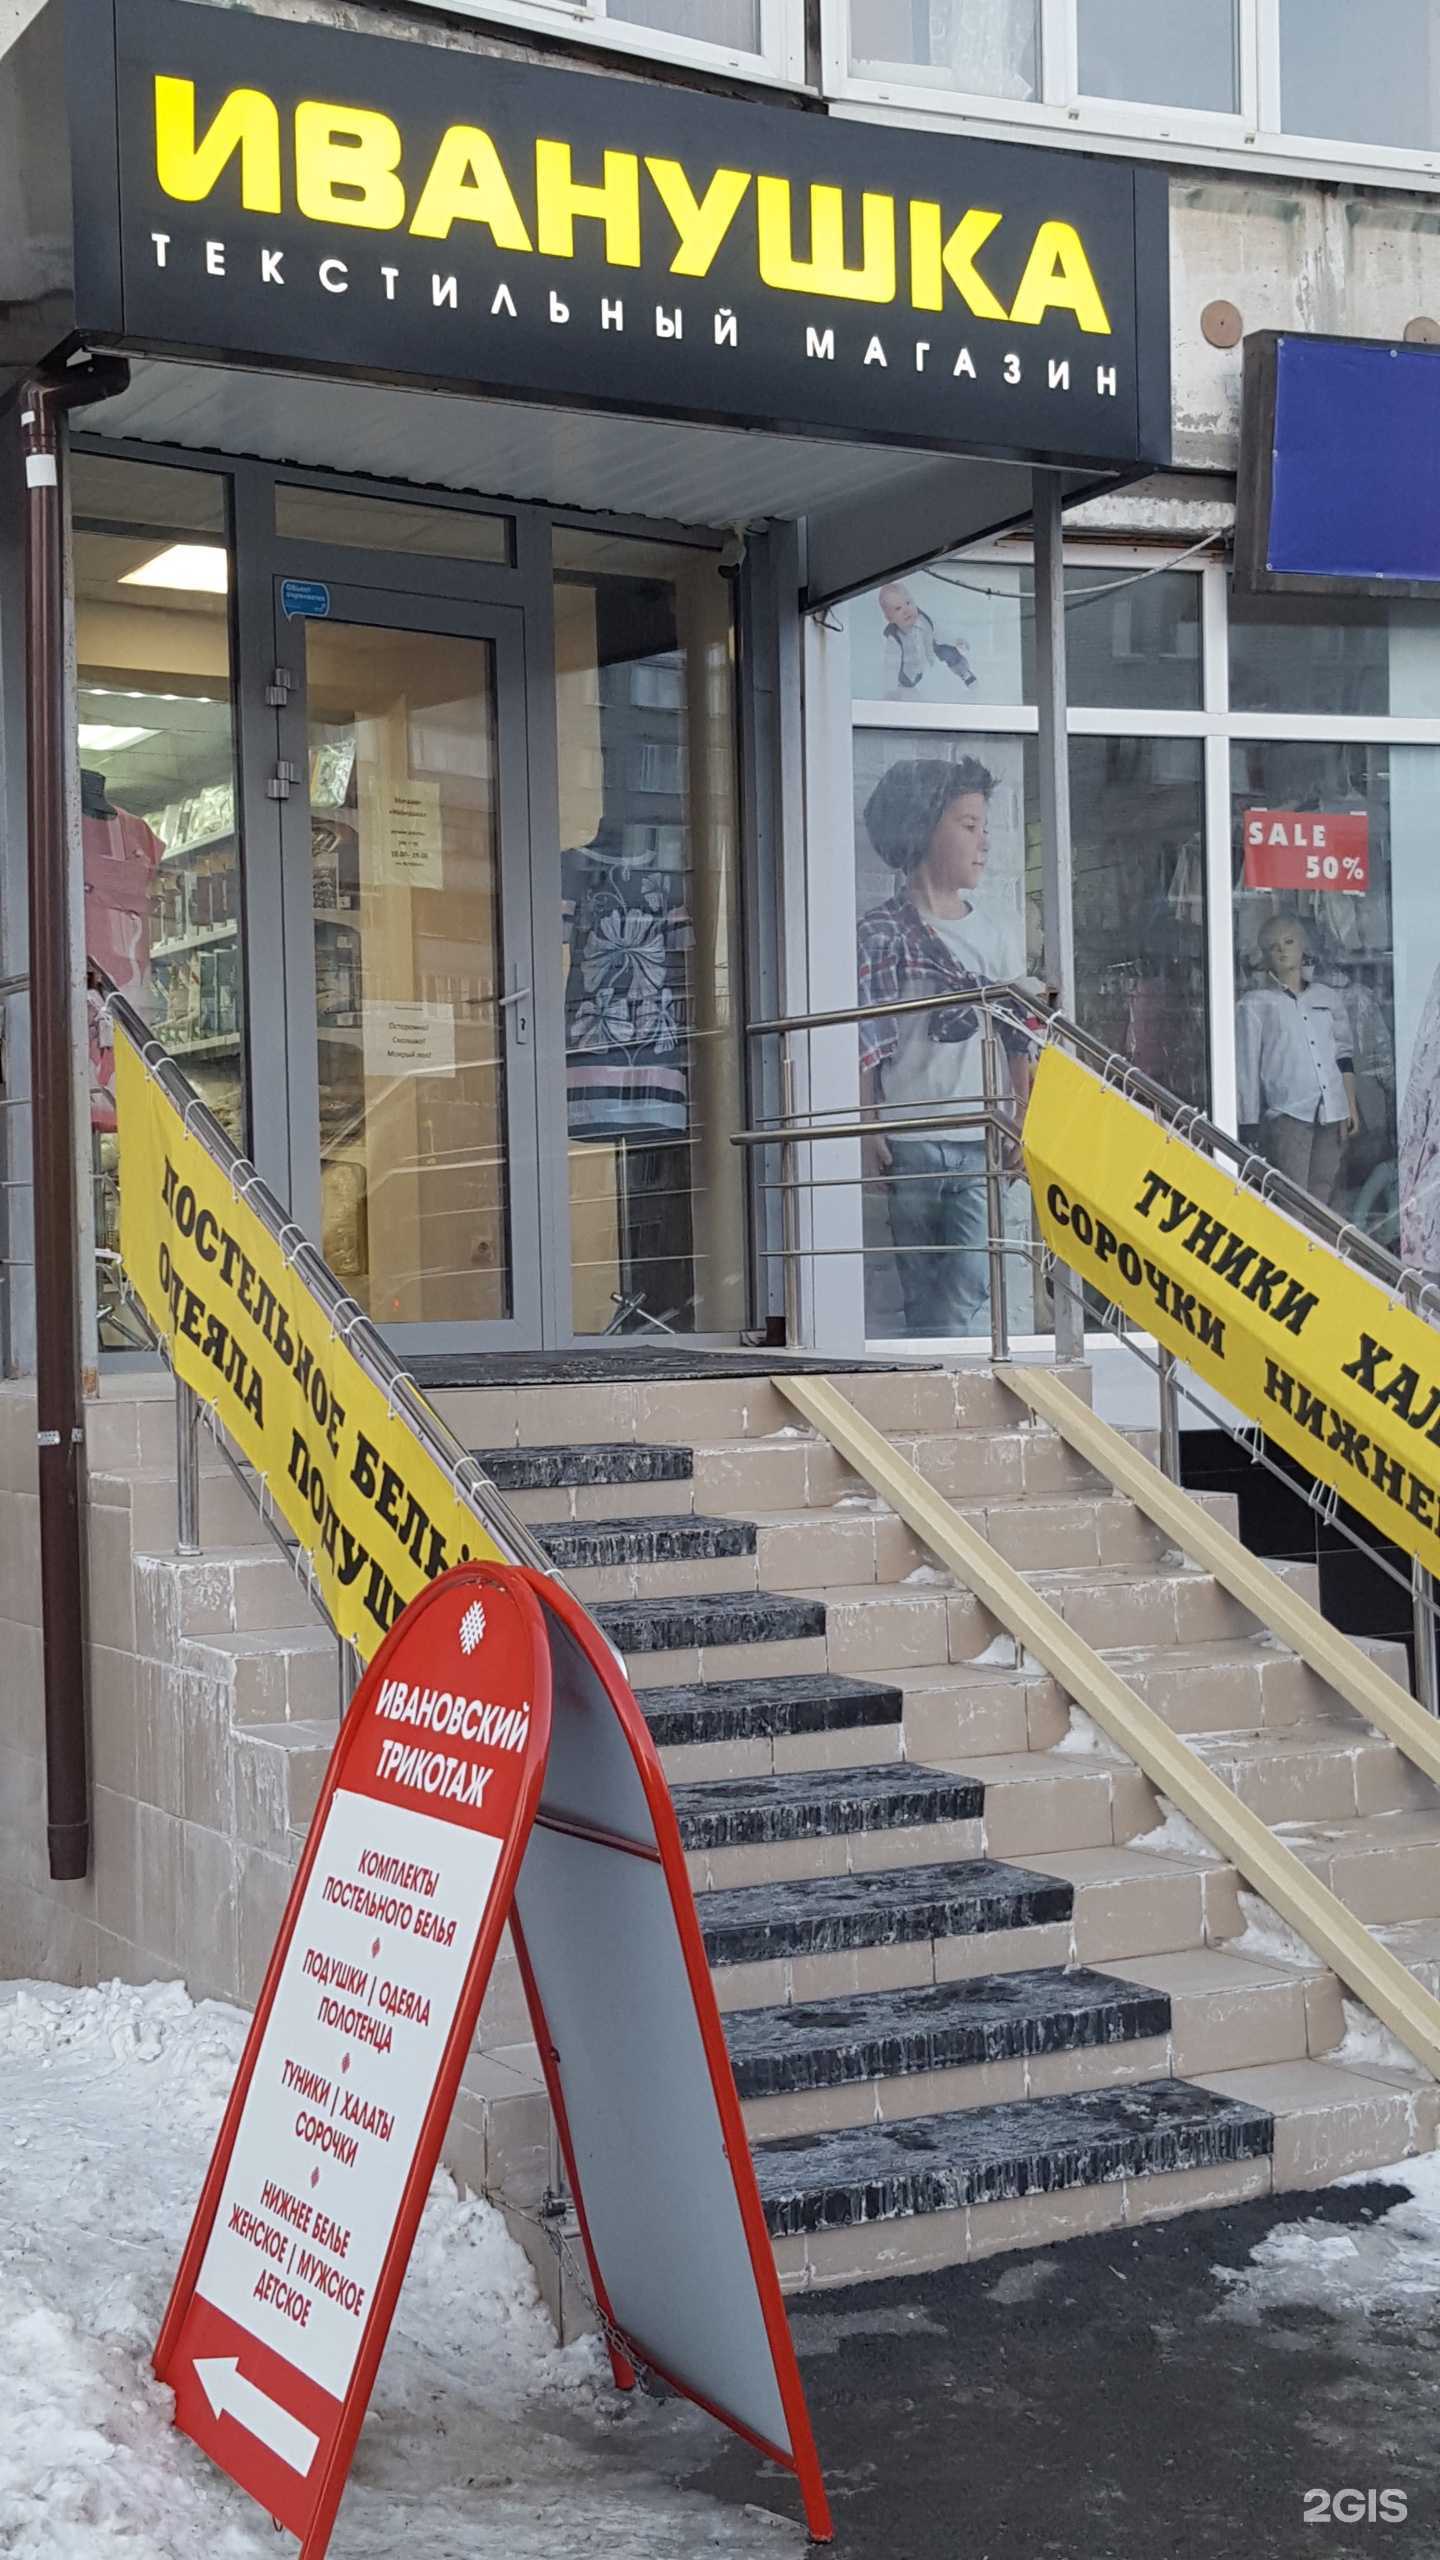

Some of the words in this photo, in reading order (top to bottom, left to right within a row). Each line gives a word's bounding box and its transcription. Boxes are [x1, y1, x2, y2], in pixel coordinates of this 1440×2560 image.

[155, 75, 1111, 335] ИВАНУШКА
[151, 233, 738, 348] ТЕКСТИЛЬНЫЙ
[806, 327, 1118, 397] МАГАЗИН
[1248, 821, 1326, 847] SALE
[1306, 855, 1364, 880] 50%
[1134, 1169, 1320, 1336] ТУНИКИ
[158, 1240, 266, 1430] ОДЕЯЛА
[161, 1155, 346, 1459] ПОСТЕЛЬНОЕ
[350, 1430, 478, 1580] БЕЛЬ
[1046, 1183, 1227, 1359] СОРОЧКИ
[1264, 1356, 1440, 1539] НИЖНЕ
[375, 1678, 531, 1754] ИВАНОВСКИЙ
[375, 1739, 495, 1809] ТРИКОТАЖ
[322, 1876, 412, 1932] ПОСТЕЛЬНОГО
[412, 1912, 457, 1948] БЕЛЬЯ
[357, 1849, 440, 1898] КОМПЛЕКТЫ
[302, 1948, 369, 1998] ПОДУШКИ
[379, 1983, 431, 2027] ОДЕЯЛА
[317, 1996, 393, 2053] ПОЛОТЕНЦА
[281, 2058, 331, 2108] ТУНИКИ
[338, 2091, 396, 2143] ХАЛАТЫ
[294, 2110, 360, 2168] СОРОЧКИ
[259, 2178, 314, 2235] НИЖНЕЕ
[313, 2218, 352, 2260] БЕЛЬЕ
[227, 2202, 289, 2264] ЖЕНСКОЕ
[297, 2251, 366, 2318] МУЖСКОЕ
[252, 2269, 313, 2329] ДЕТСКОЕ
